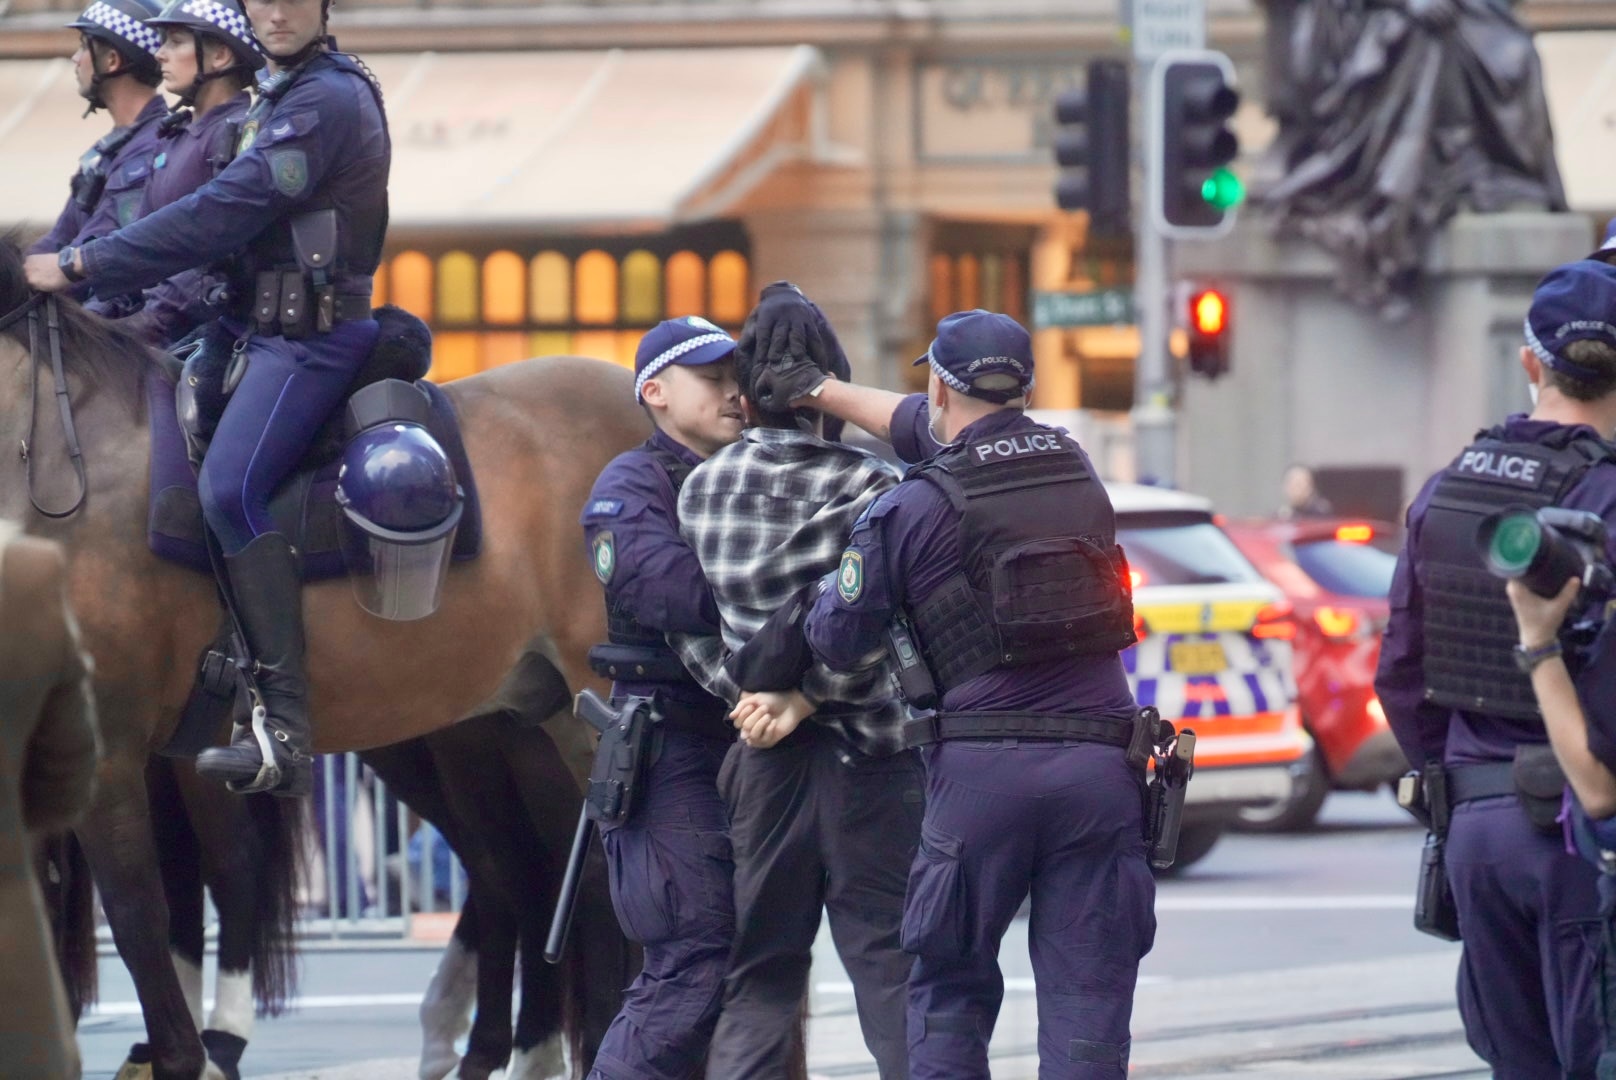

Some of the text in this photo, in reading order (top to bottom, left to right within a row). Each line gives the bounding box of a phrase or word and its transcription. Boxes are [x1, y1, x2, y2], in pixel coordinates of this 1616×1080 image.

[982, 356, 1008, 364] POLICE
[975, 434, 1061, 461] POLICE
[1458, 451, 1540, 482] POLICE
